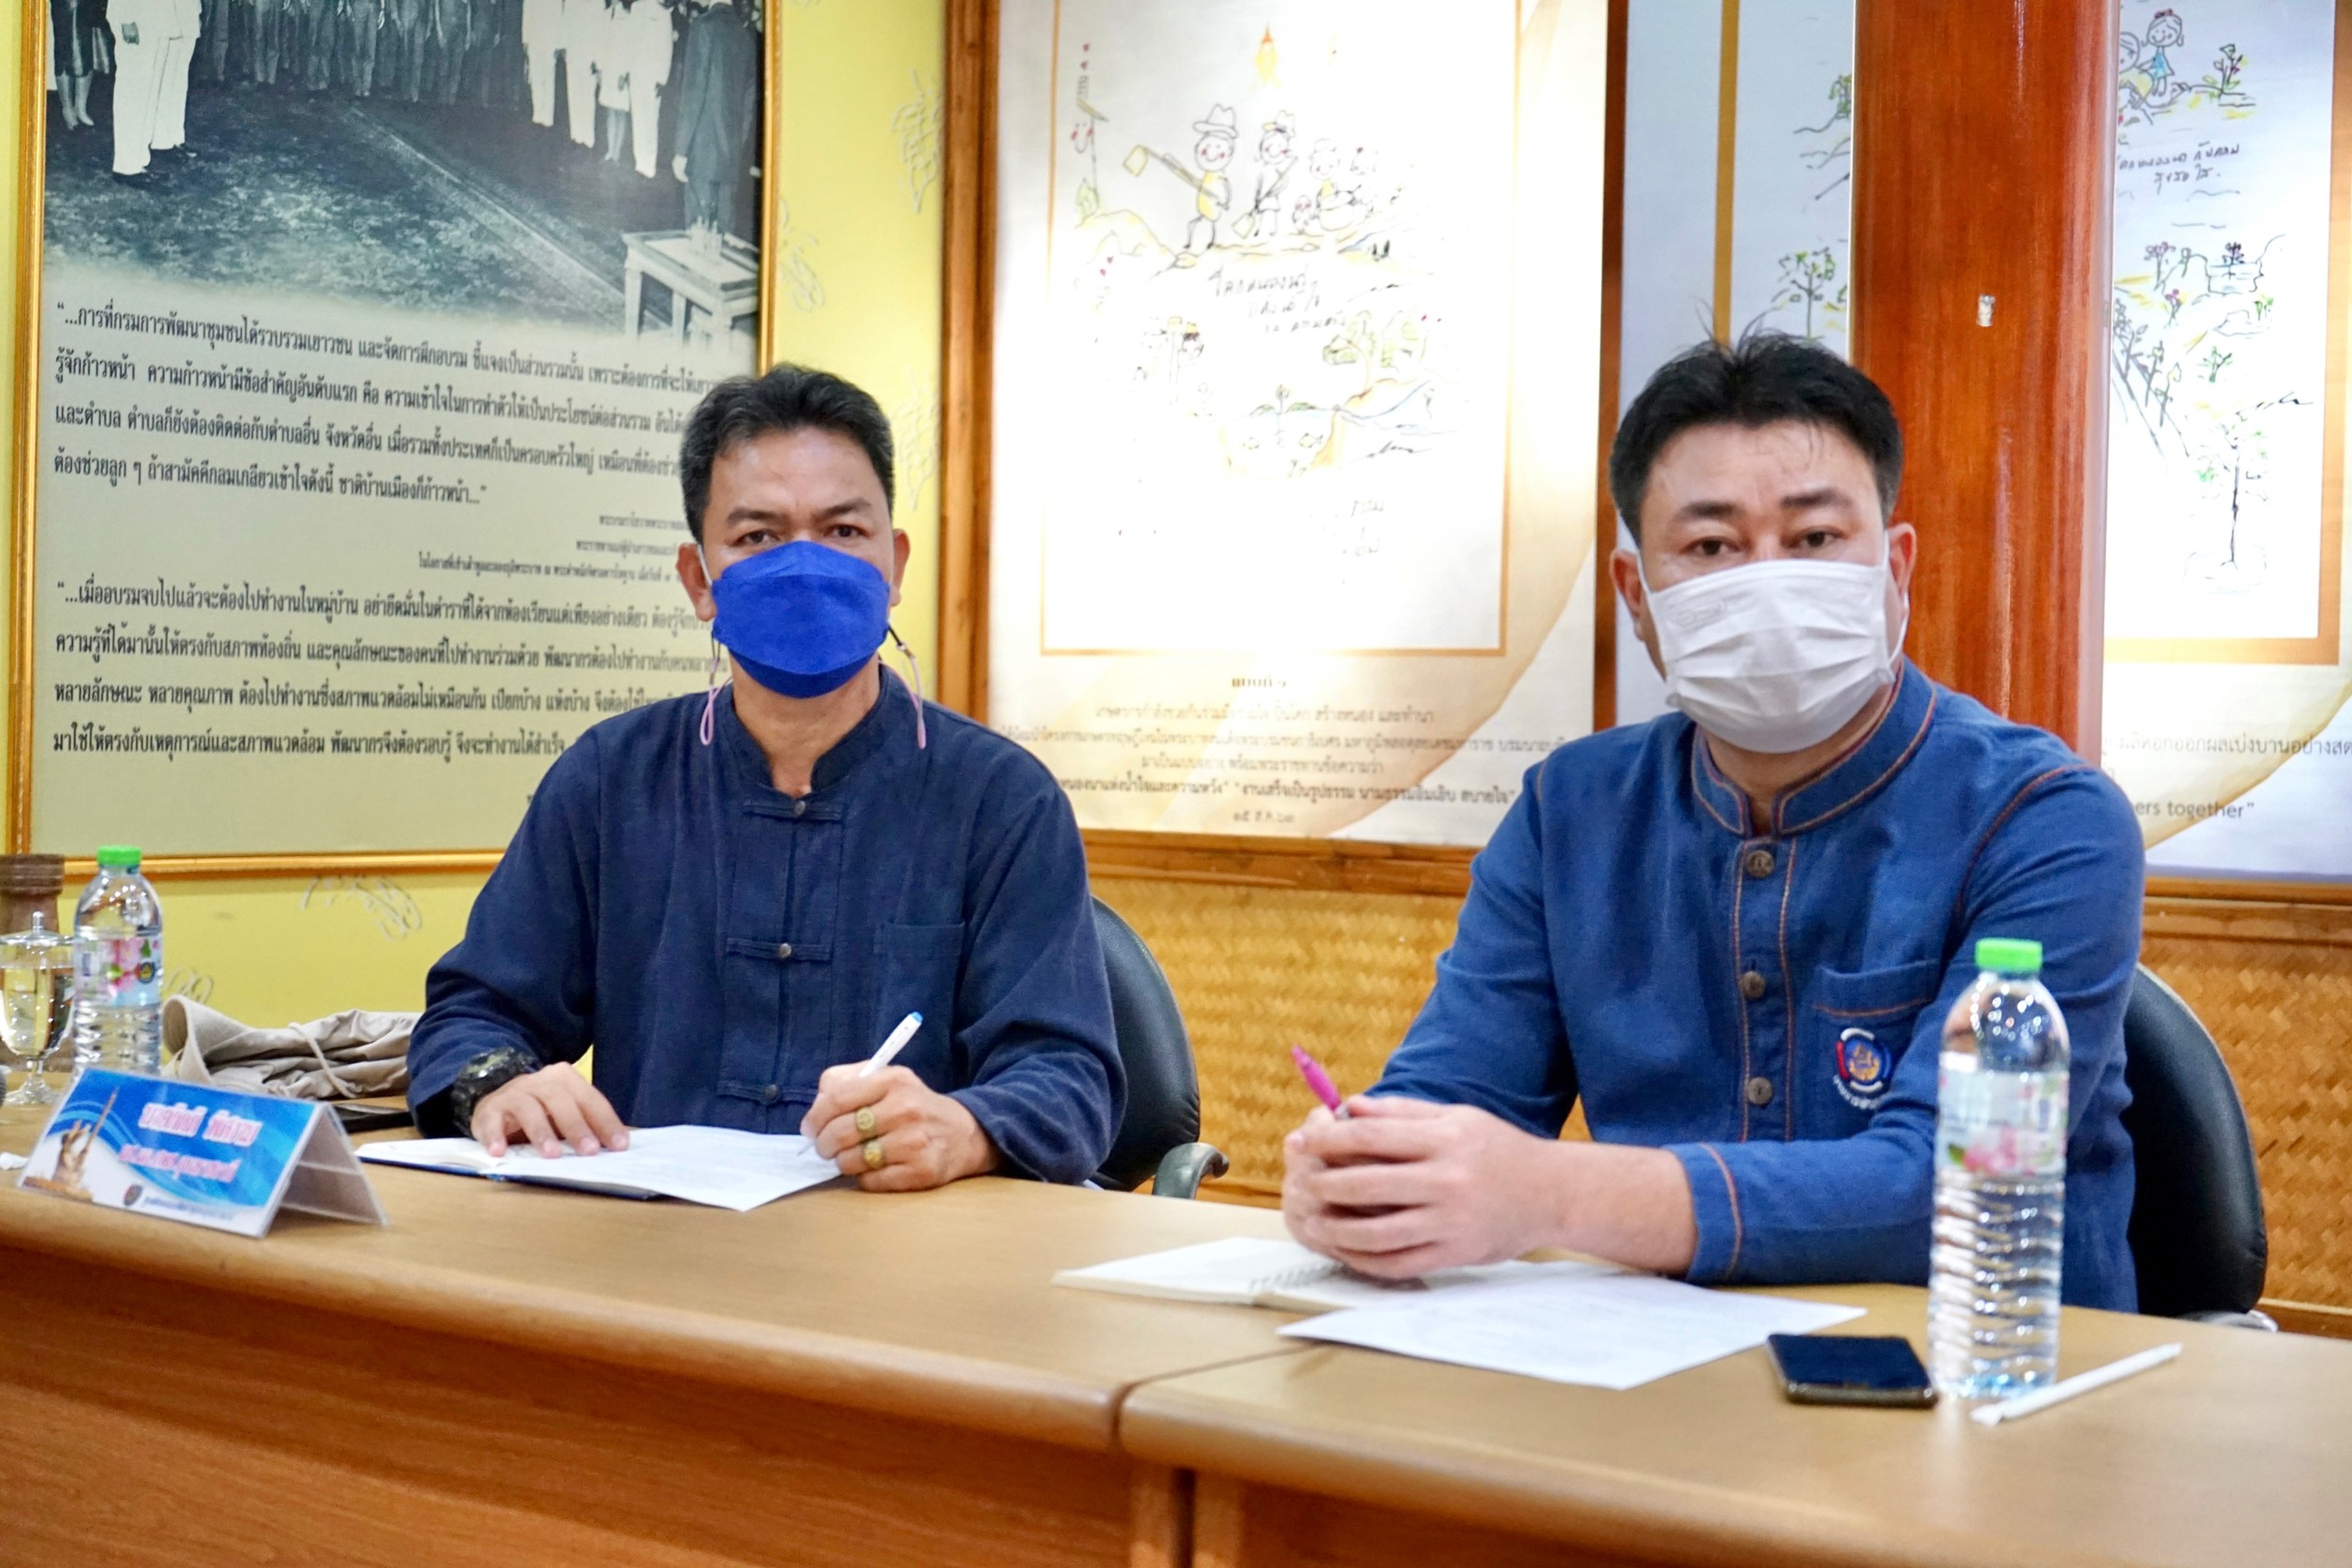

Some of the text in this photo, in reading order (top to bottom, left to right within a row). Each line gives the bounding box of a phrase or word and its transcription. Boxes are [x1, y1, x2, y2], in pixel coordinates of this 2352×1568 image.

[55, 347, 136, 384] รู้จักก้าวหน้า
[363, 379, 379, 404] คือ
[54, 400, 122, 429] และตำบล
[325, 421, 382, 452] จังหวัดอื่น
[54, 676, 142, 702] หลายลักษณะ
[148, 683, 234, 714] หลายคุณภาพ
[2134, 801, 2161, 816] ers
